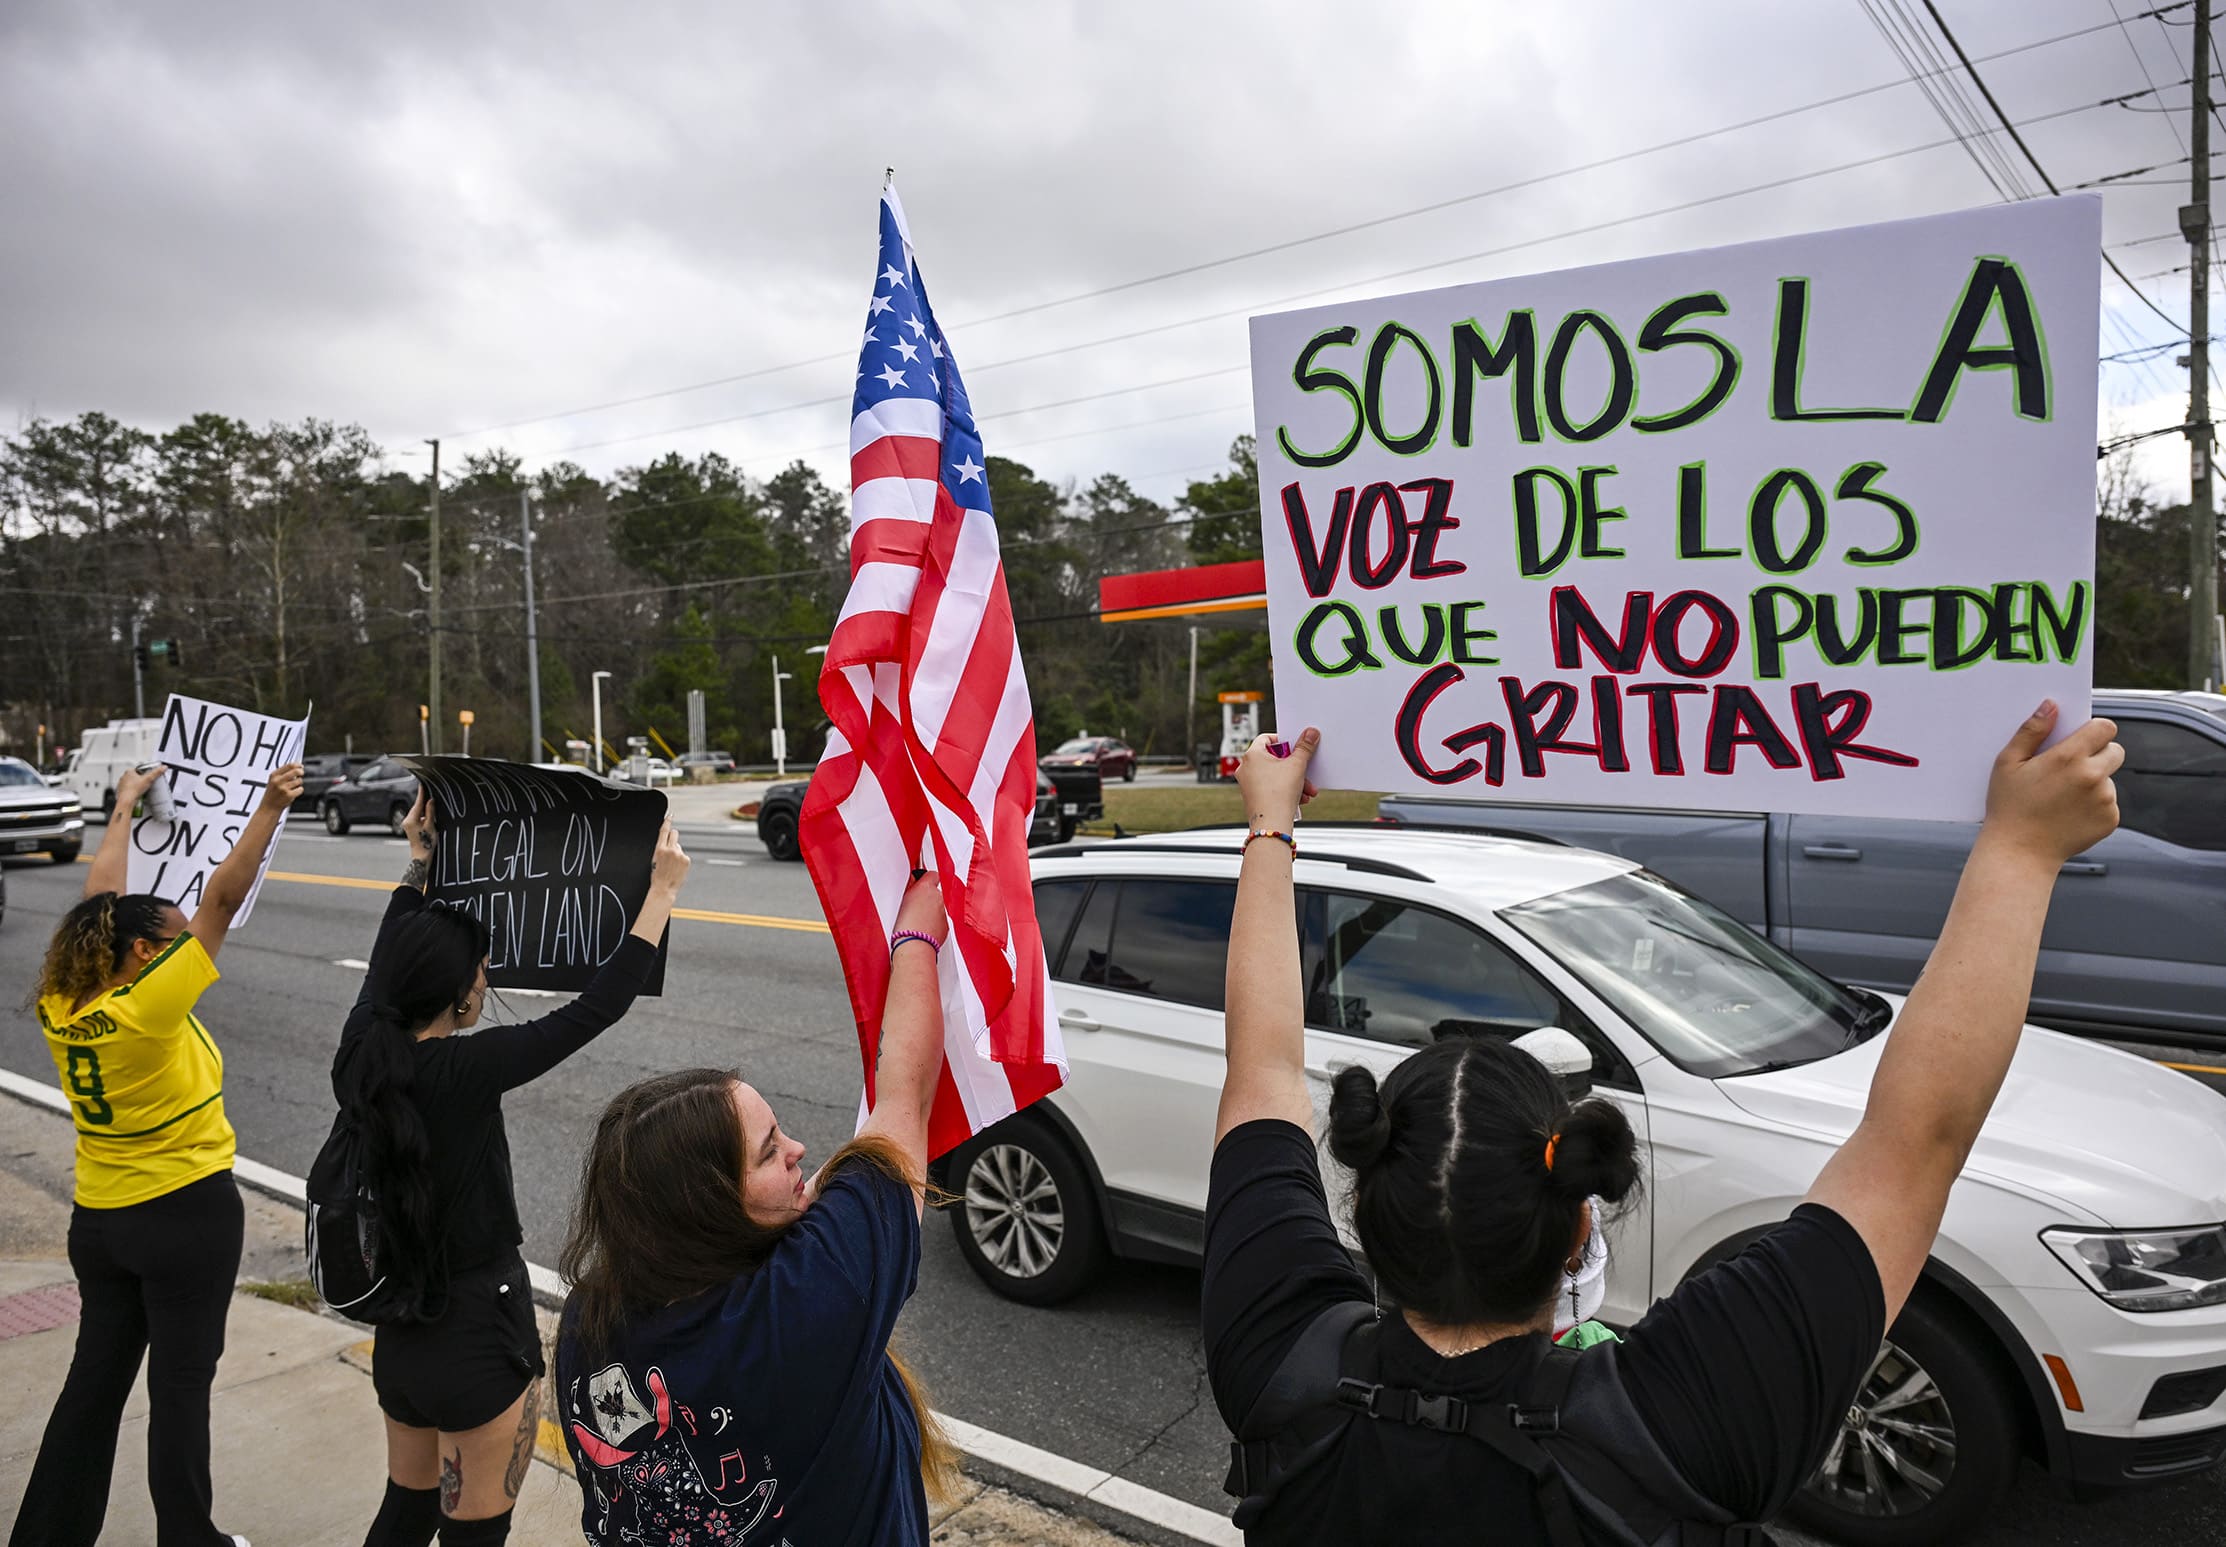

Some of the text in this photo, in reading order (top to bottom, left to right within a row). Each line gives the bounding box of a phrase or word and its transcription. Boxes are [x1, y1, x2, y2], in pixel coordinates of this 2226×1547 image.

[1277, 255, 2052, 467] SOMOS LA
[1282, 461, 1920, 598] VOZ DE LOS
[1295, 580, 2090, 679] QUE NO PUEDEN
[158, 698, 242, 767] NO
[1396, 662, 1919, 786] GRITAR
[161, 761, 267, 817] IS I
[132, 816, 239, 866] ON S
[434, 812, 608, 887] ILLEGAL ON
[151, 861, 204, 907] LA
[538, 884, 627, 968] LAND
[67, 1045, 113, 1125] 9
